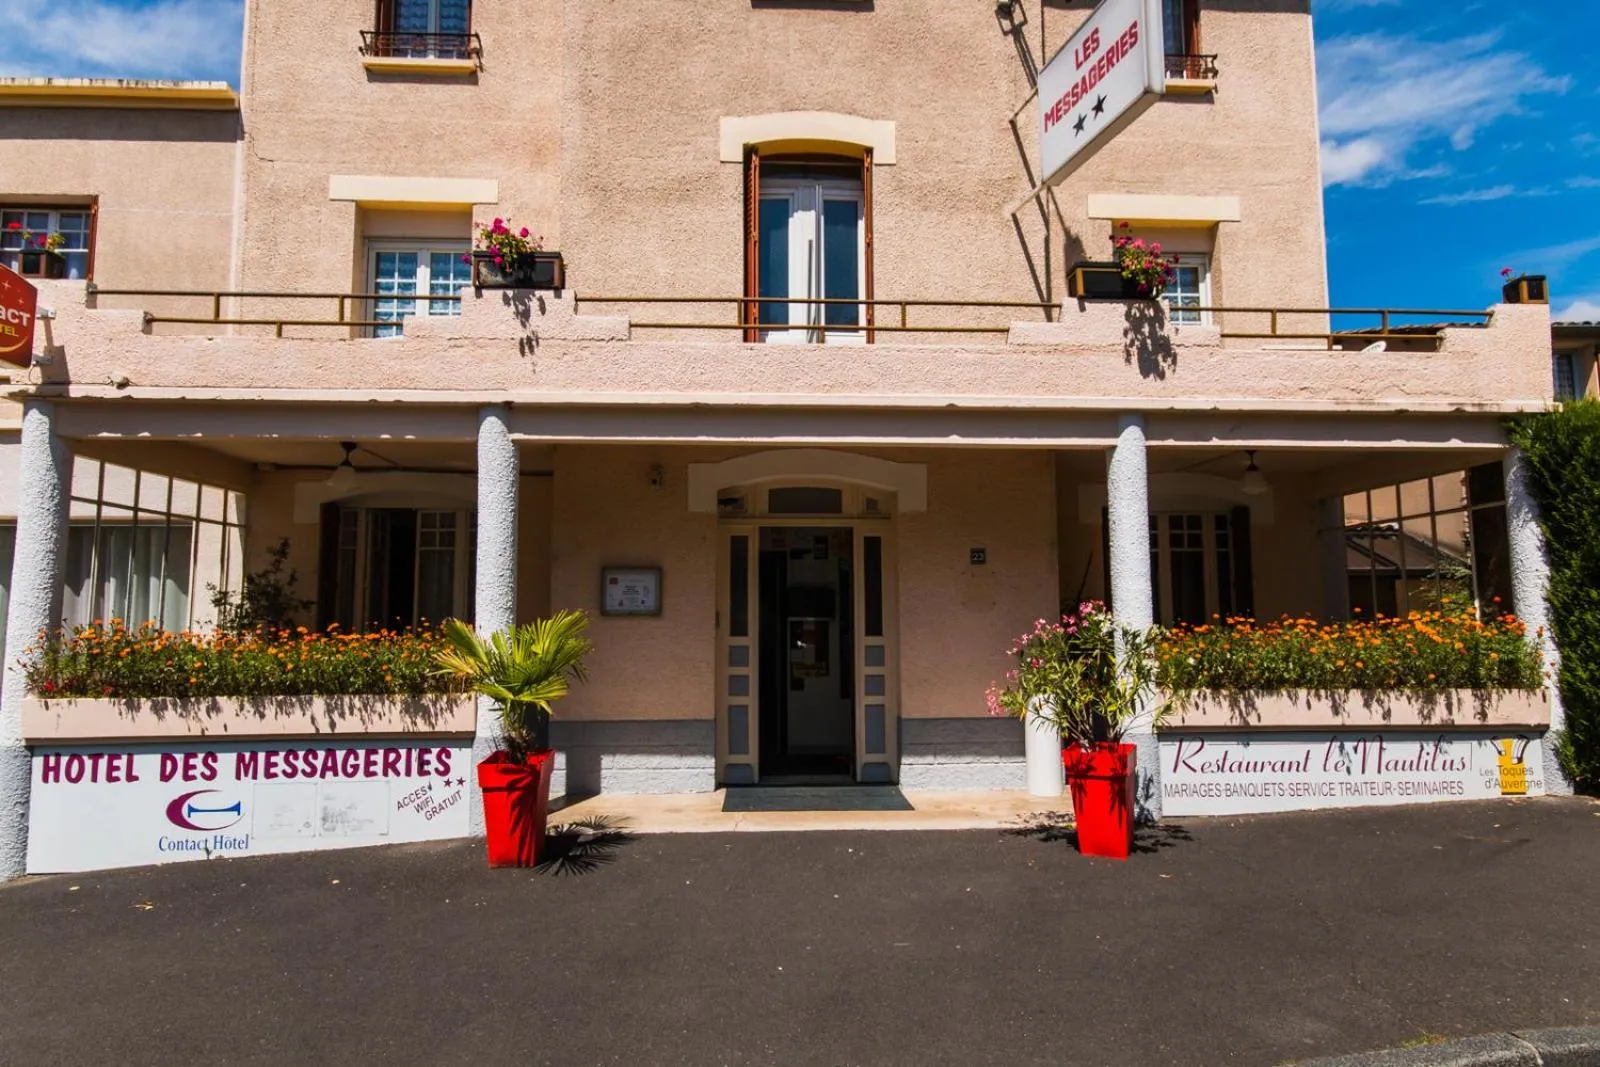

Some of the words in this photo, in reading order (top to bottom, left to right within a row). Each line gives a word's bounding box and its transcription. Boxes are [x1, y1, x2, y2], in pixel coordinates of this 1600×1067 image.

[1074, 26, 1101, 71] LES
[1044, 20, 1138, 133] MESSAGERIES
[42, 752, 139, 784] HOTEL
[159, 750, 219, 782] DES
[235, 746, 452, 780] MESSAGERIES
[1173, 736, 1310, 776] Restaurant
[1323, 735, 1346, 774] le
[1353, 736, 1467, 777] Nautilus
[1479, 767, 1494, 777] Les
[1496, 764, 1534, 778] Toques
[1484, 777, 1543, 792] d'Auvergne
[396, 785, 428, 811] ACCES
[413, 795, 435, 814] WIFI
[424, 789, 462, 821] GRATUIT
[158, 835, 208, 851] Contact
[212, 833, 250, 850] Hôtel
